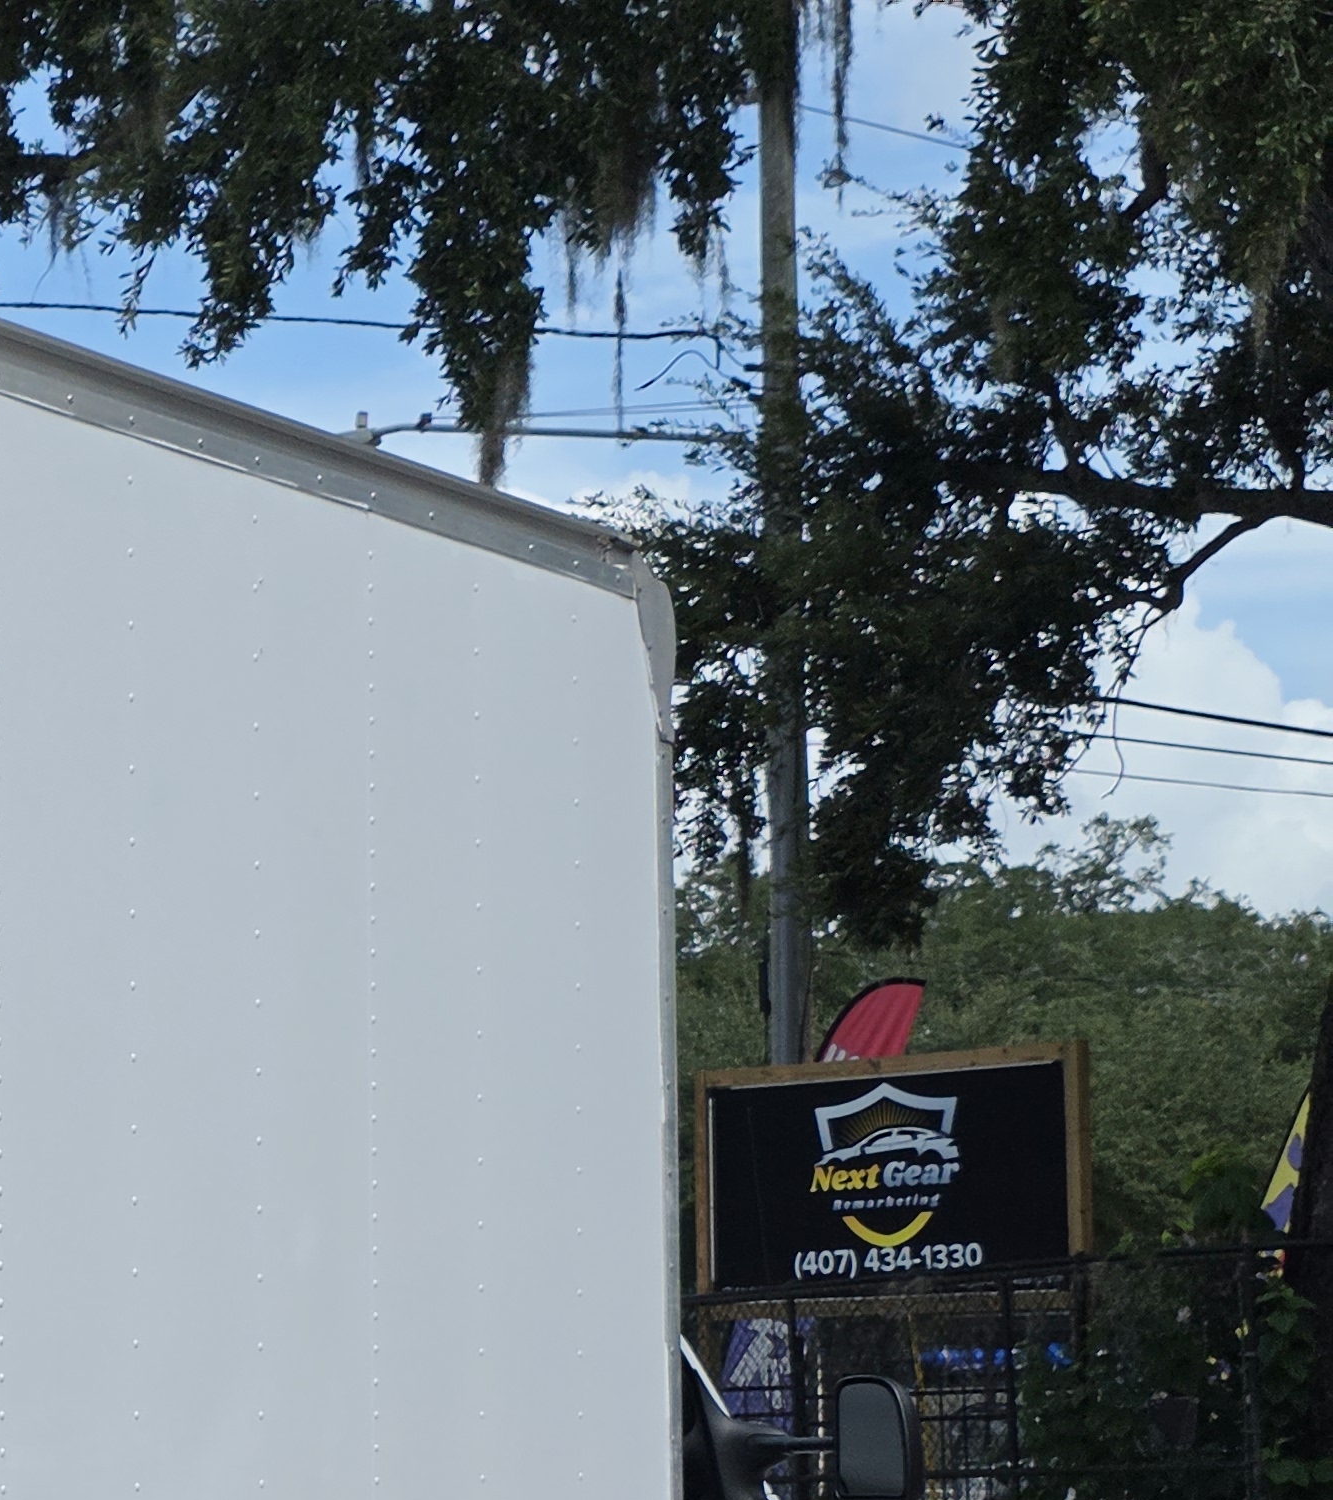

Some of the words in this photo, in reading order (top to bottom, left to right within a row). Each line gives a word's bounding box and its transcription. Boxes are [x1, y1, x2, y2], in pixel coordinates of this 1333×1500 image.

[810, 1164, 881, 1192] Next
[883, 1161, 960, 1187] Gear
[833, 1193, 941, 1211] Remarketing
[794, 1249, 858, 1280] (407)
[864, 1242, 983, 1272] 434-1330
